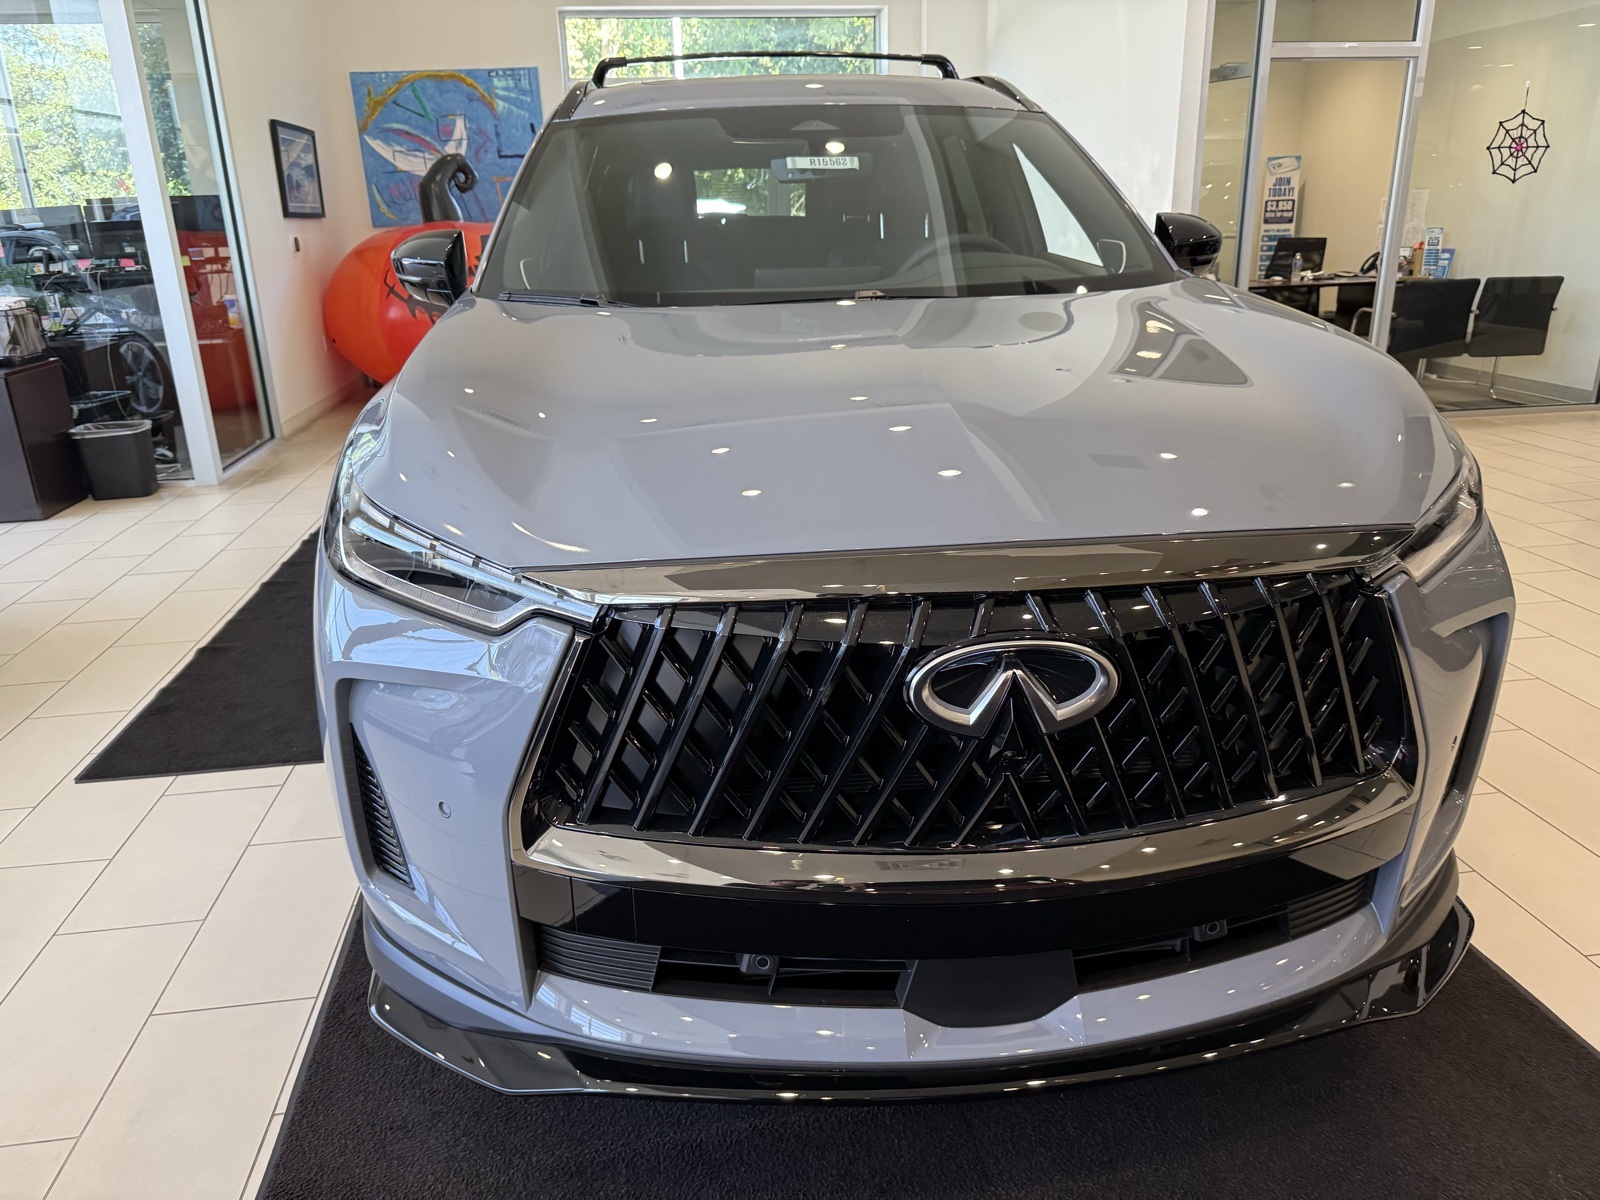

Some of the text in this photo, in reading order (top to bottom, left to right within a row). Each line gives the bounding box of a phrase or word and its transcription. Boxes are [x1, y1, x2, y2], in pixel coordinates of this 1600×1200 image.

[809, 158, 848, 167] R15562
[1273, 177, 1291, 187] JOIN
[1268, 187, 1294, 198] TODAY!
